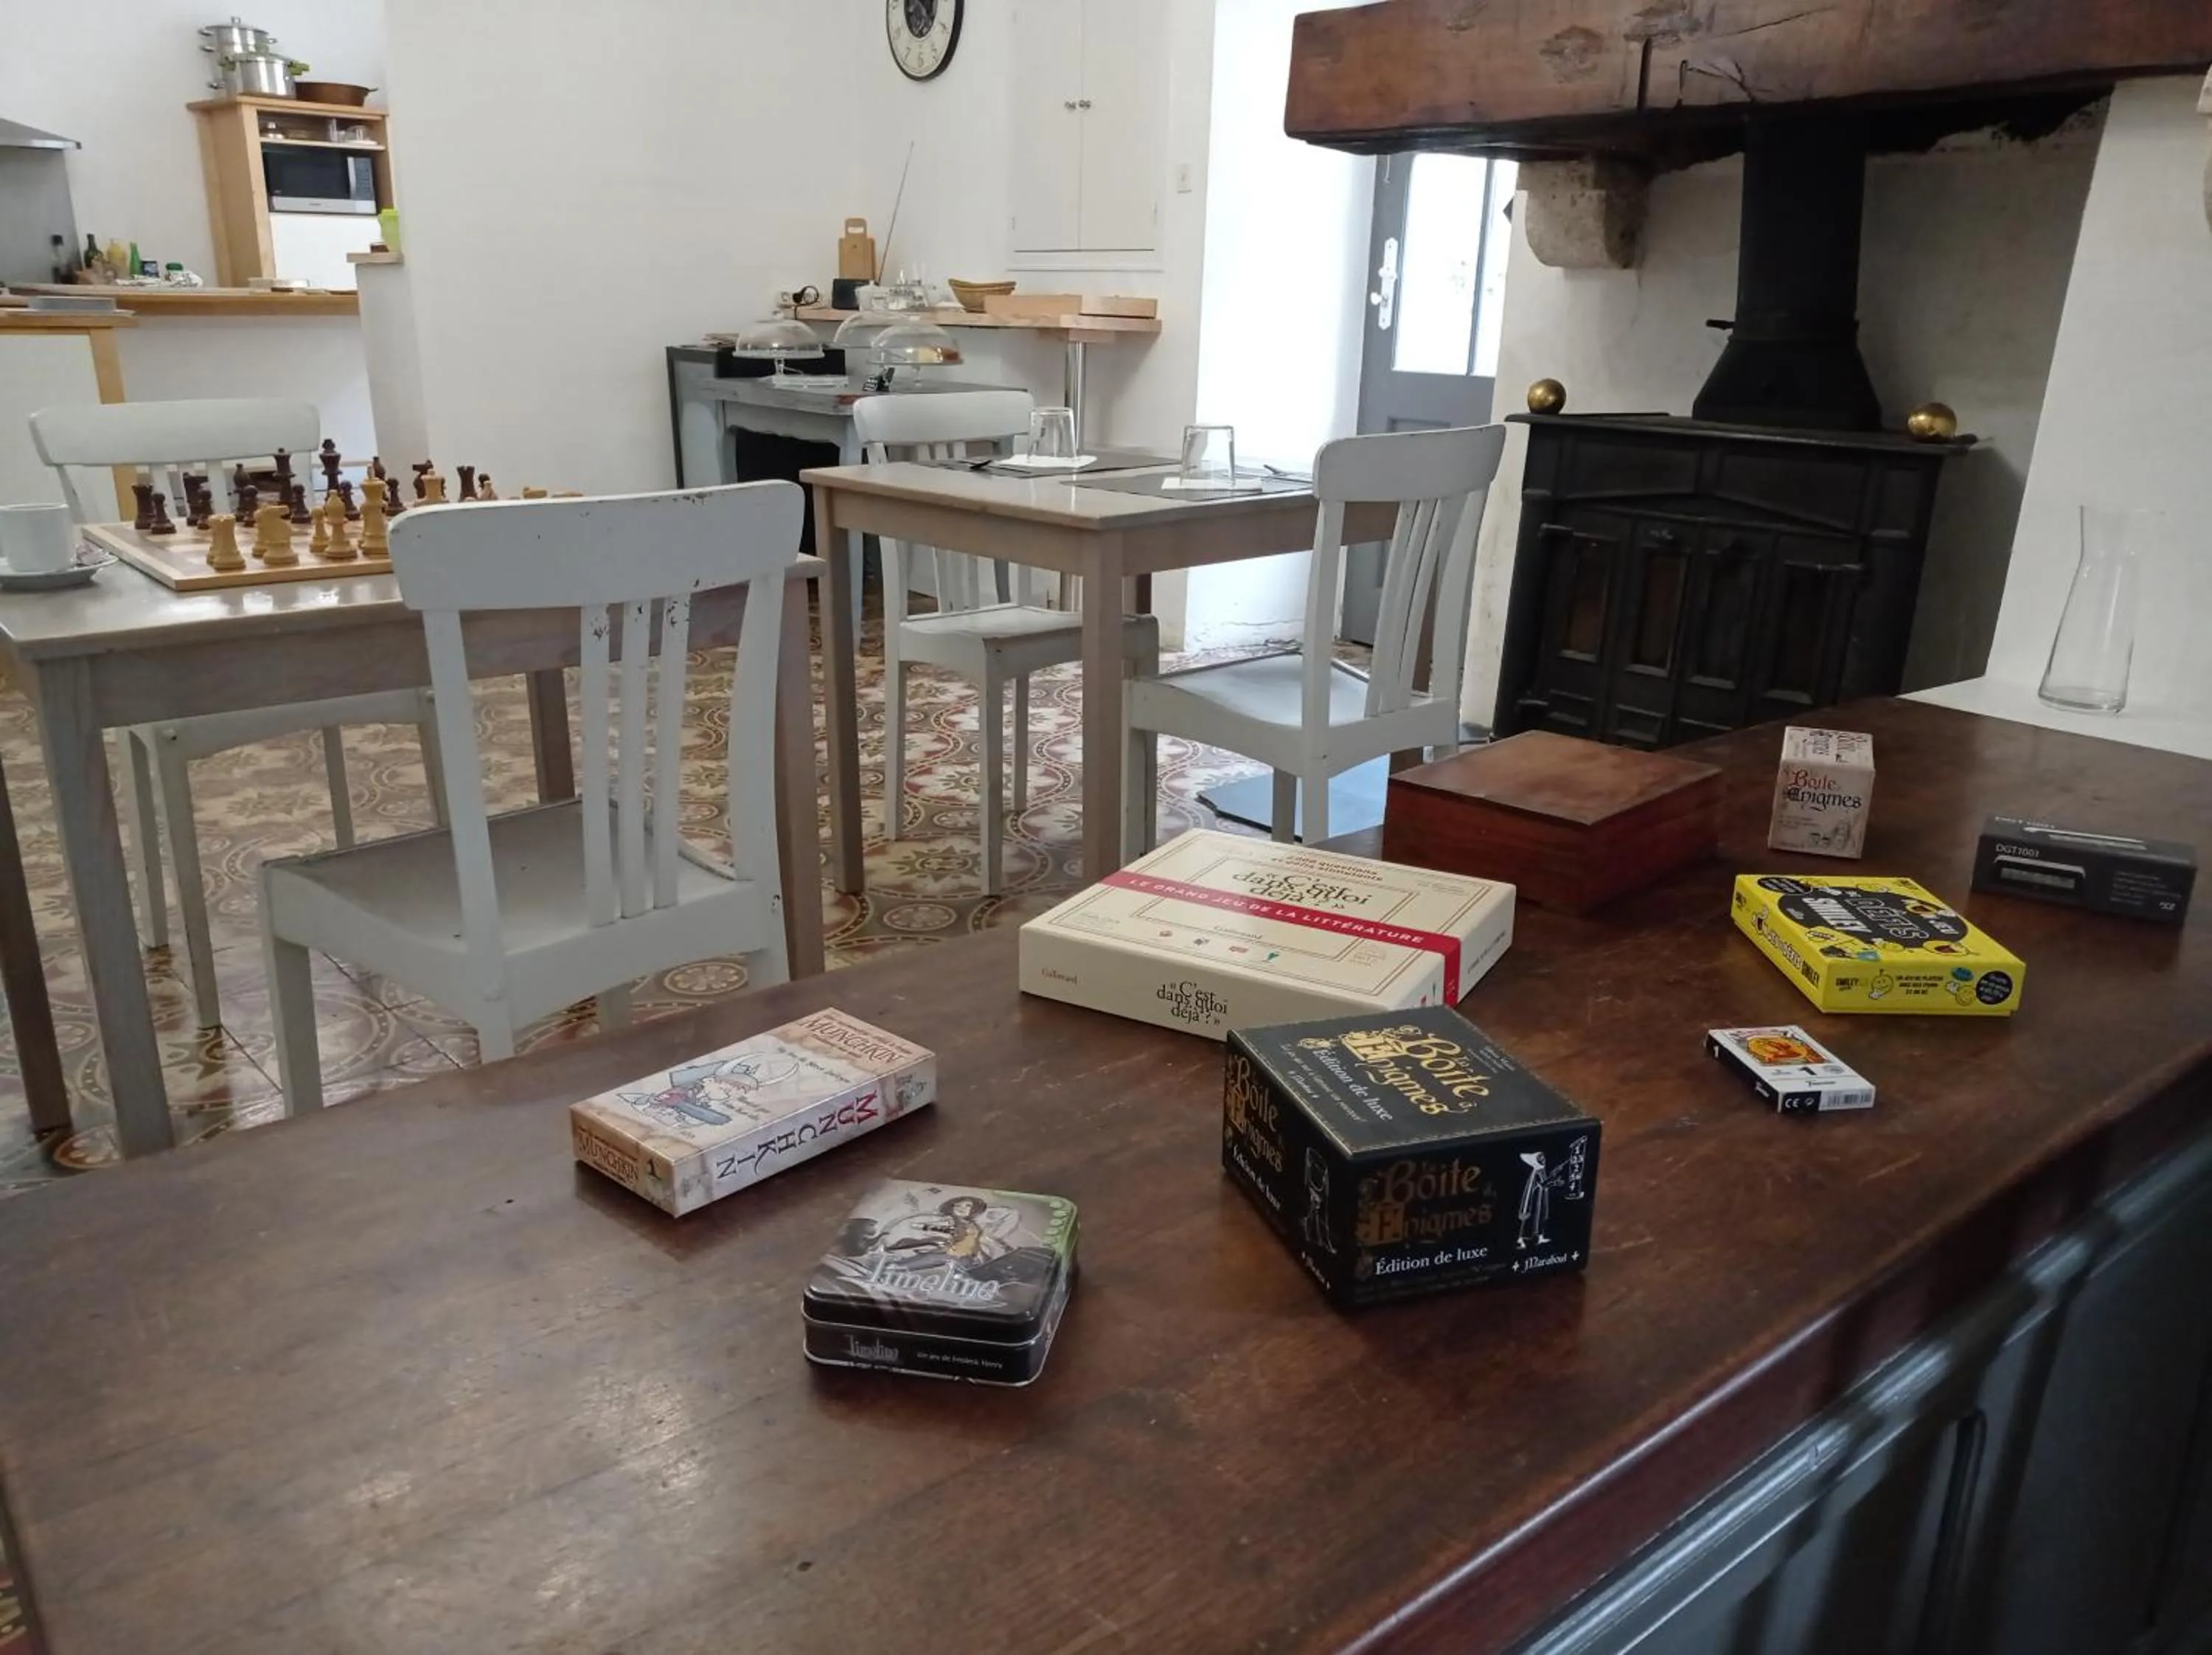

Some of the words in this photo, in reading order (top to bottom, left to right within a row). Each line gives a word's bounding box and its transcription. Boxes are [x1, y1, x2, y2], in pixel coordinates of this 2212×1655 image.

[1154, 884, 1208, 901] GRAND
[1211, 896, 1245, 907] JEU
[1248, 902, 1273, 913] DE
[1276, 909, 1297, 919] LA
[1802, 897, 1873, 933] SMILEY
[801, 1017, 905, 1064] MUNCHKIN
[1349, 1083, 1368, 1097] de
[1363, 1097, 1393, 1120] luxe
[716, 1089, 878, 1179] MUNCHKIN
[647, 1157, 662, 1181] 1
[1374, 1257, 1430, 1276] Édition
[1434, 1250, 1453, 1266] de
[1456, 1246, 1488, 1262] luxe
